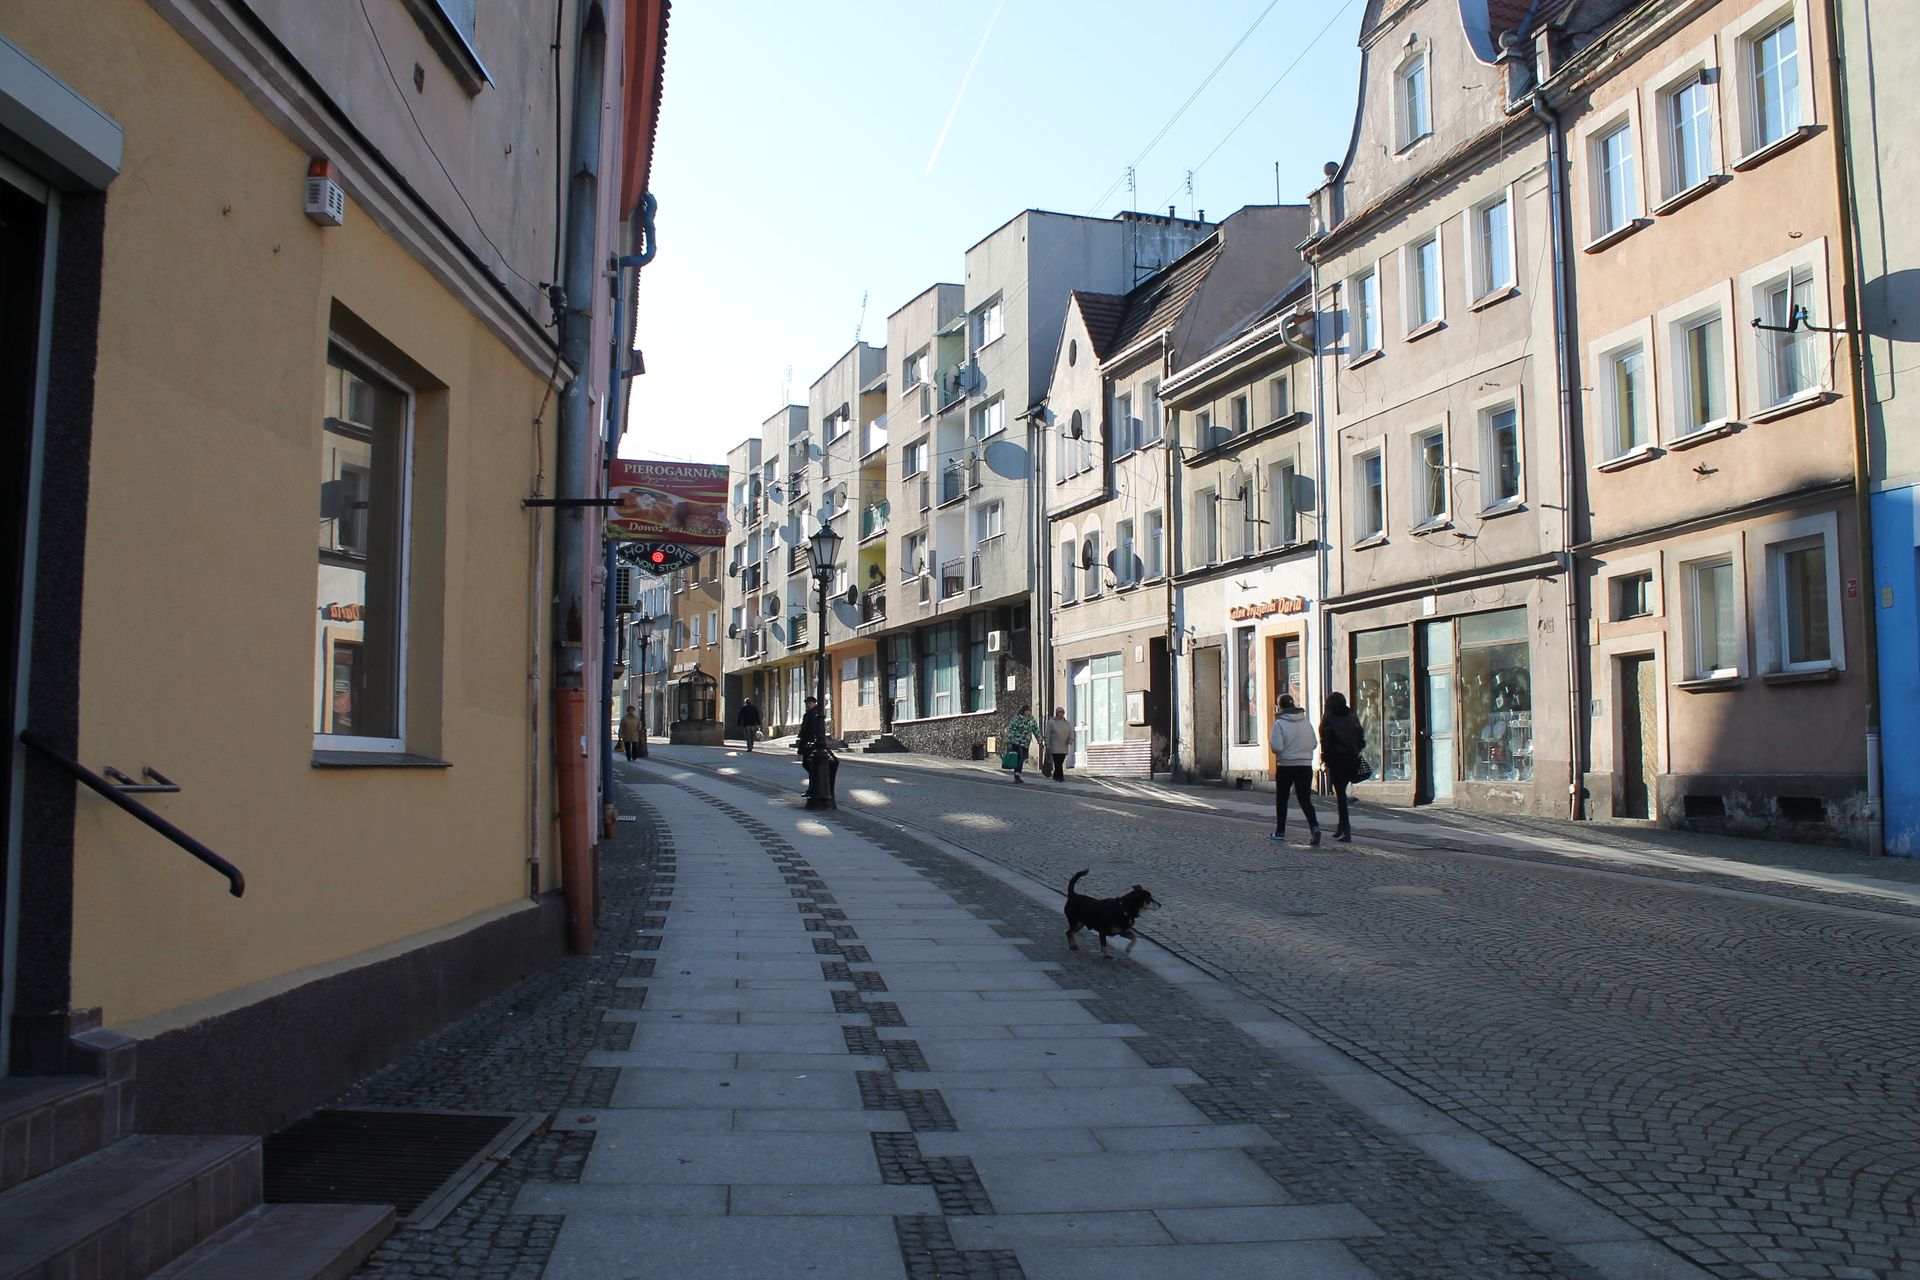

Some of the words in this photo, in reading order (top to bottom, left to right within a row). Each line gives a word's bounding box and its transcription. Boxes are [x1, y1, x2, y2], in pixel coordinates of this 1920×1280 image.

[624, 463, 717, 478] PIEROGARNIA
[625, 544, 650, 558] HOT
[657, 544, 694, 563] ZONE
[636, 557, 656, 570] NON
[658, 561, 682, 572] STOP
[1278, 595, 1305, 614] Daria
